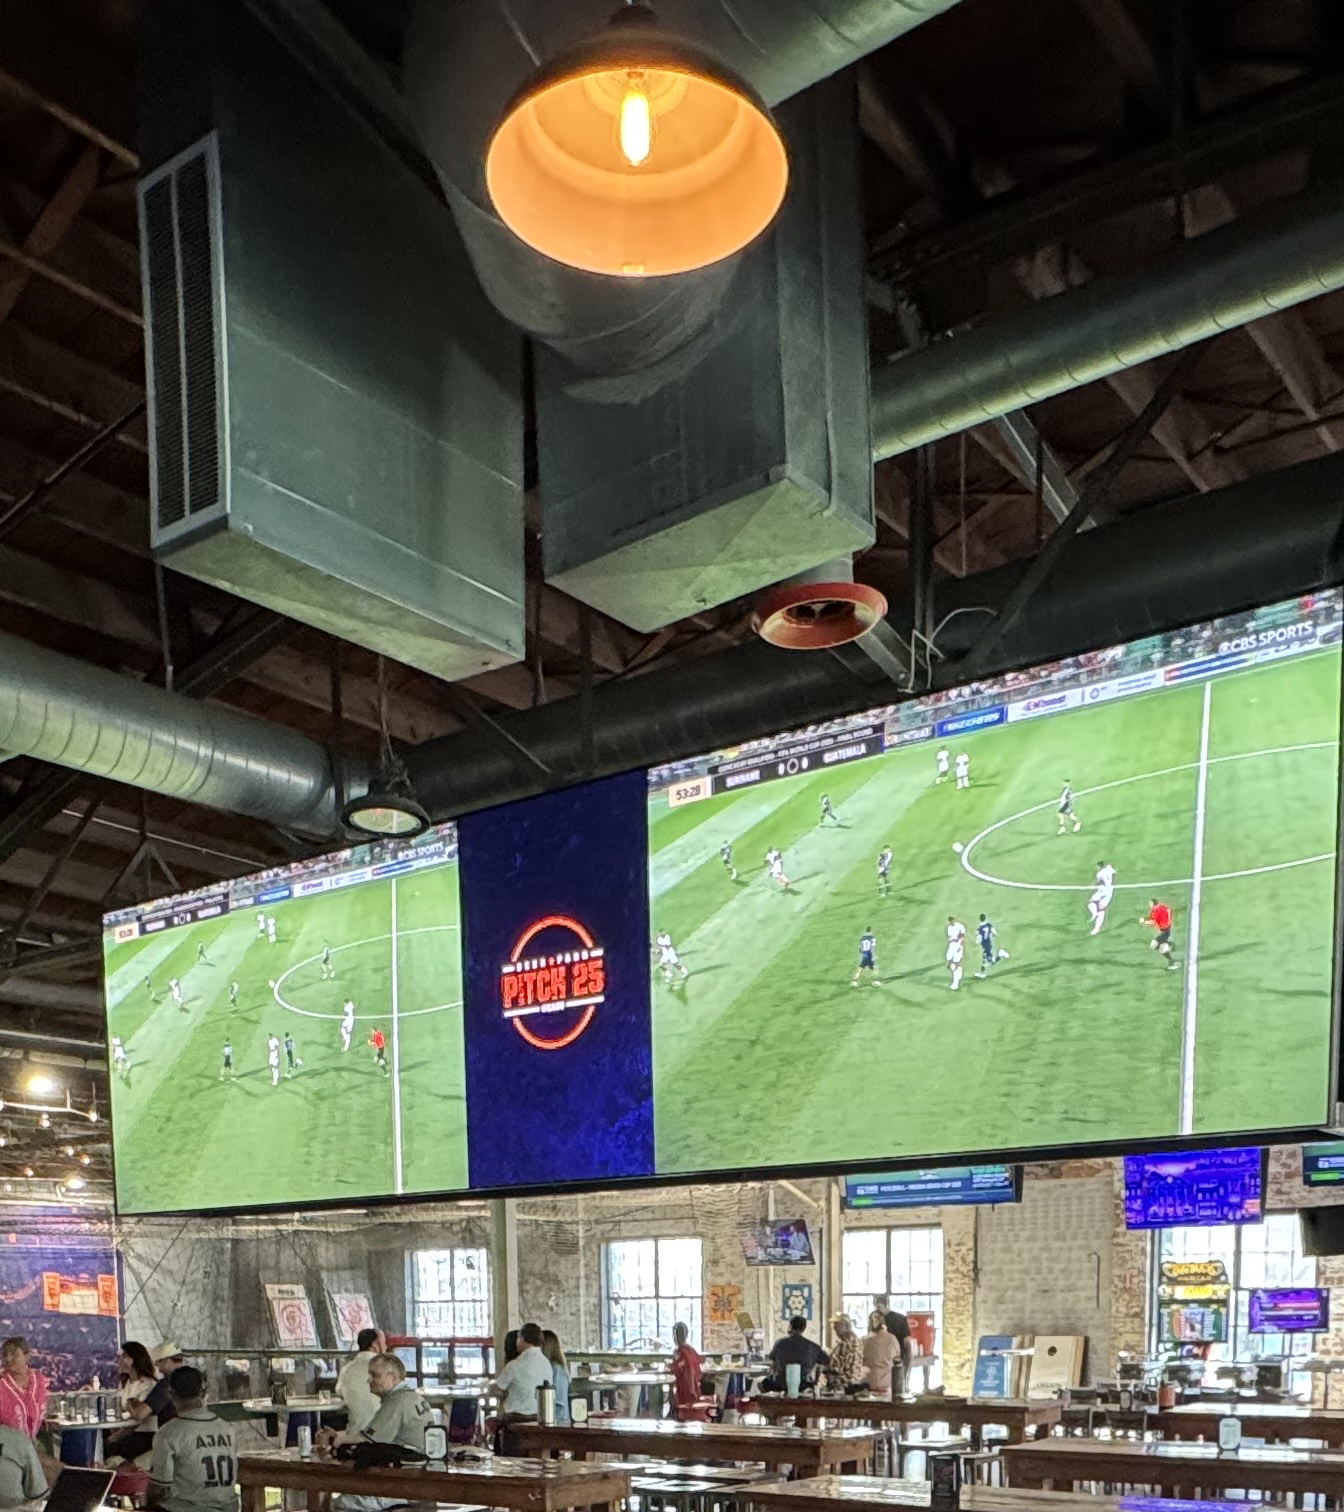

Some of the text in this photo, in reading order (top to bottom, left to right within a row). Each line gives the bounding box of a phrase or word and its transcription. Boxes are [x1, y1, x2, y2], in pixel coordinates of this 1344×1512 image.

[1230, 621, 1314, 653] CBS SPORTS
[502, 959, 605, 1009] PITCH 25
[201, 1455, 234, 1488] 10
